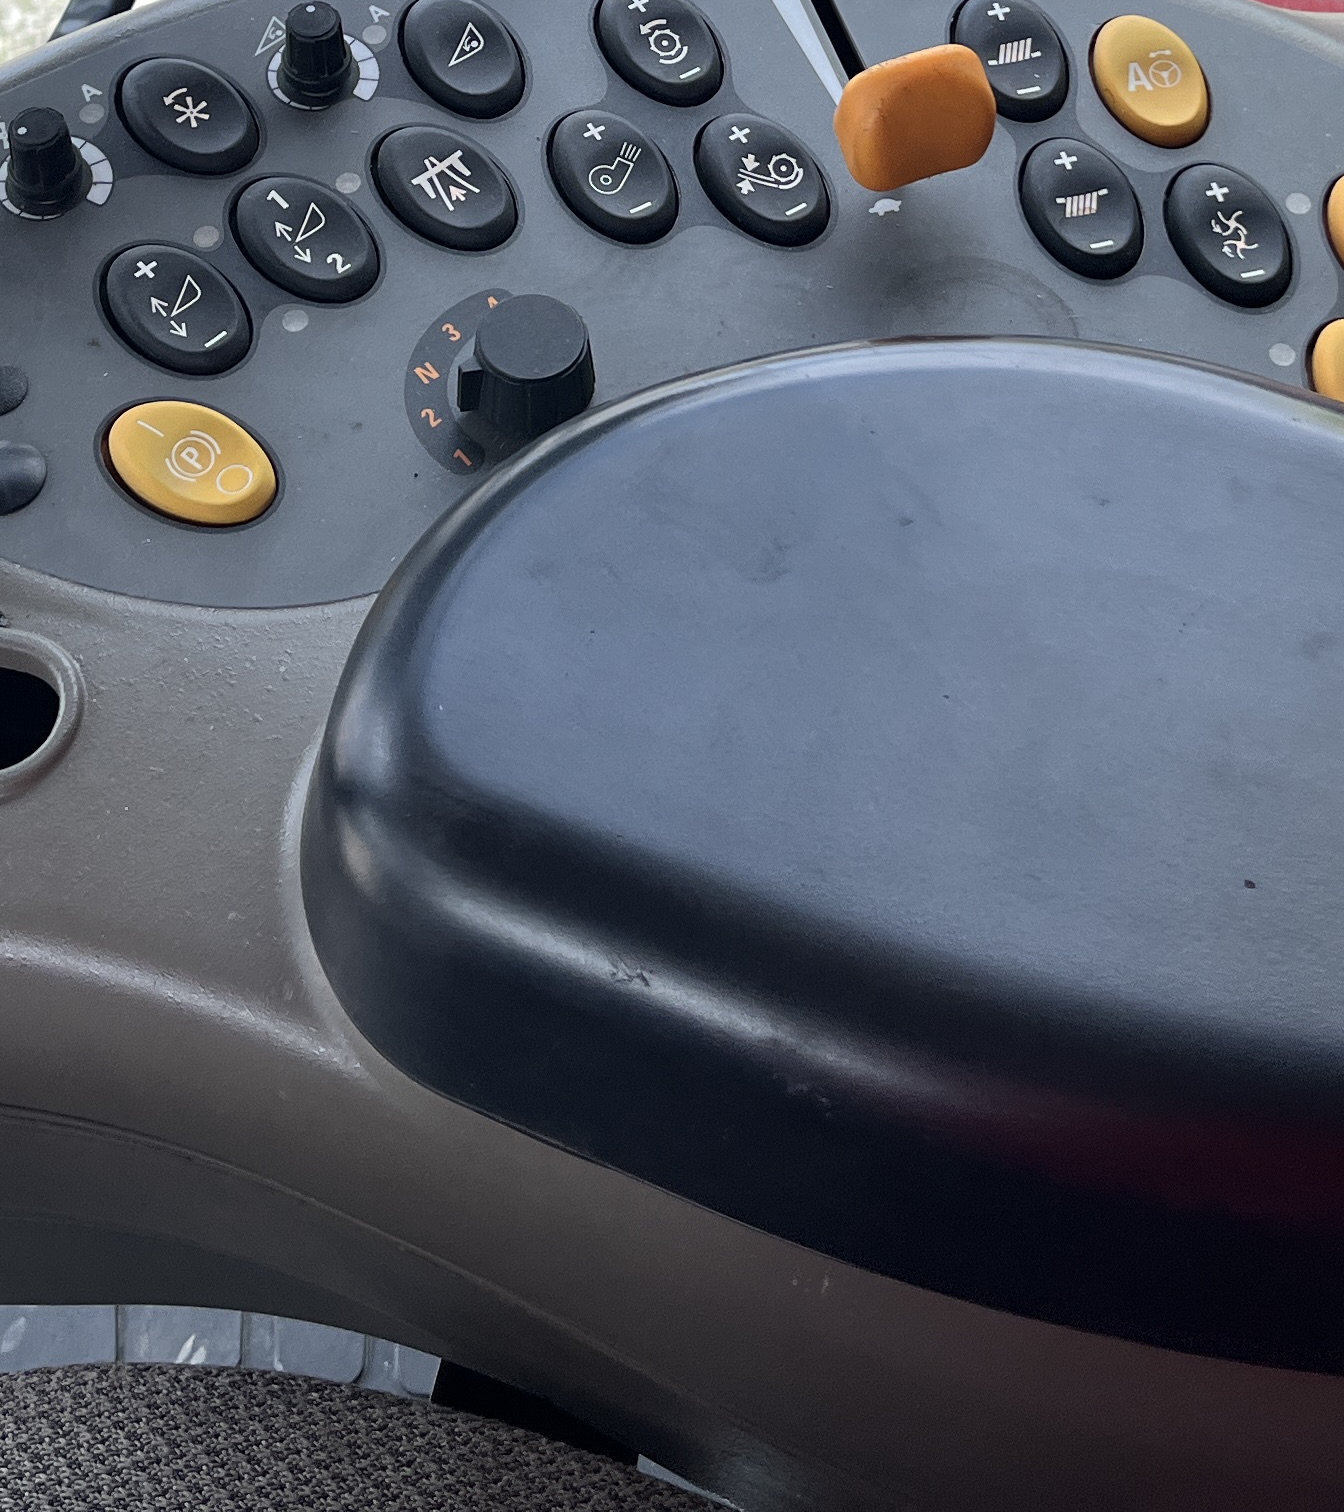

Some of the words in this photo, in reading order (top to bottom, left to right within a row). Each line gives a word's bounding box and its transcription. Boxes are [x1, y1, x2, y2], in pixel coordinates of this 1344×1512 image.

[368, 4, 390, 24] A
[1128, 62, 1154, 92] A
[81, 83, 103, 102] A
[266, 189, 290, 209] 1
[326, 253, 352, 274] 2
[441, 323, 462, 342] 3
[414, 361, 441, 385] N
[421, 408, 444, 428] 2
[453, 448, 473, 467] 1
